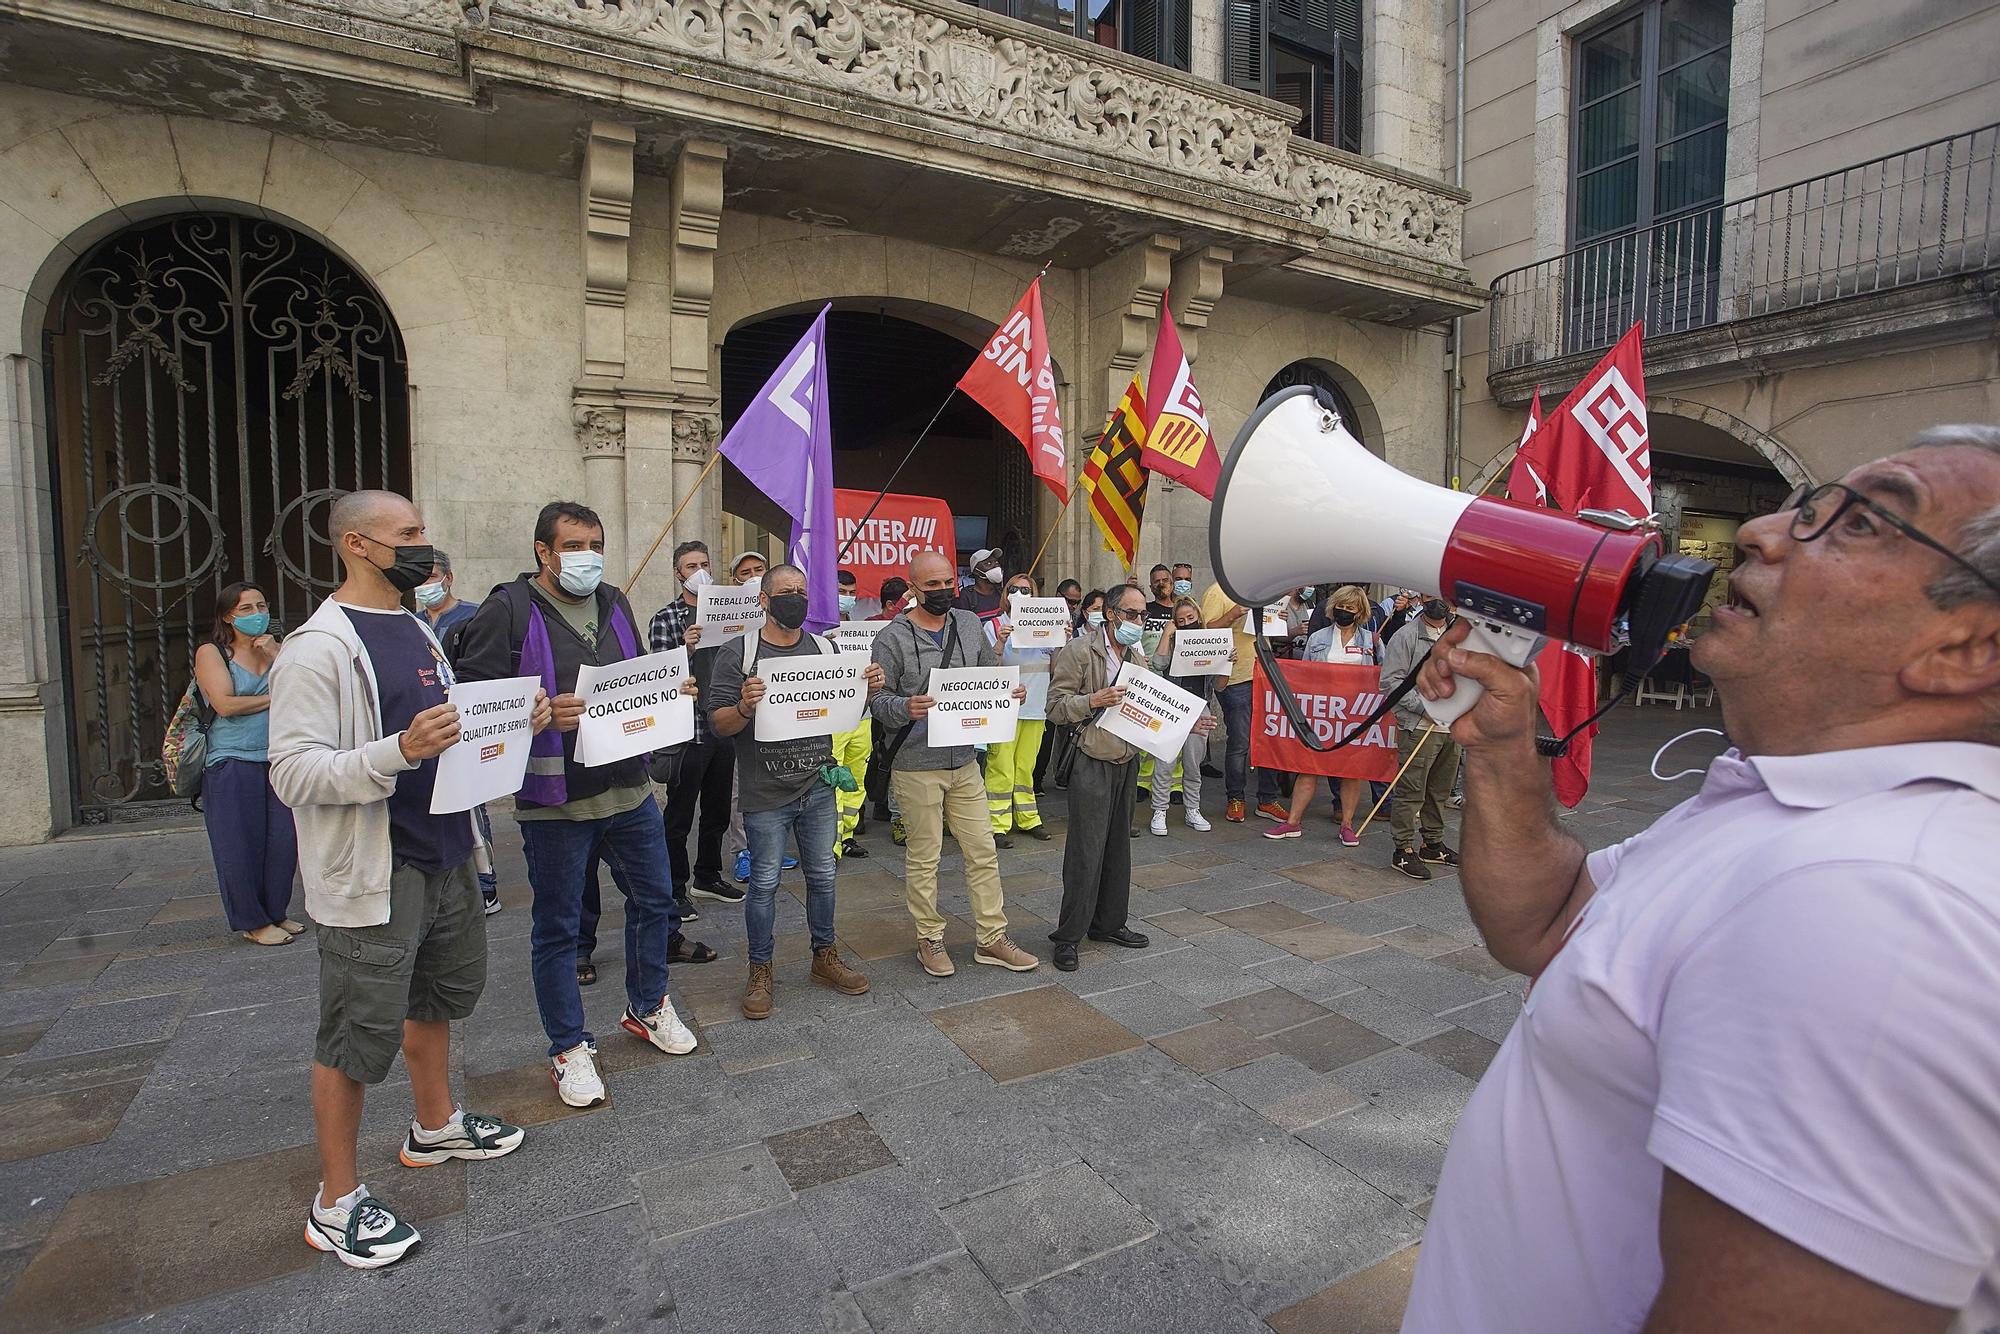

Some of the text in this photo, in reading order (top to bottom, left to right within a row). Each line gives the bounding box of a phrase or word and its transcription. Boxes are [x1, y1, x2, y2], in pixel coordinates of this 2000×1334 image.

[837, 517, 907, 543] INTER
[708, 597, 742, 606] TREBALL
[706, 610, 764, 622] TREBALL SEGUR
[1020, 606, 1065, 614] NEGOCIACIÓ SI
[1018, 619, 1055, 627] COACCIONS
[840, 630, 869, 638] TREBALL
[1183, 636, 1221, 645] NEGOCIACIÓ
[840, 643, 869, 651] TREBALL
[1180, 649, 1216, 657] COACCIONS
[593, 665, 680, 694] NEGOCIACIÓ SI
[771, 667, 856, 683] NEGOCIACIÓ SI
[941, 678, 1010, 692] NEGOCIACIÓ SI
[588, 688, 678, 719] COACCIONS NO
[769, 688, 856, 705] COACCIONS NO
[1148, 686, 1190, 714] TREBALLAR
[472, 695, 526, 716] CONTRACTACIÓ
[938, 699, 1010, 712] COACCIONS NO
[1125, 689, 1136, 700] MB
[1136, 696, 1180, 724] SEGURETAT
[463, 724, 497, 742] QUALITAT
[498, 723, 506, 734] DE
